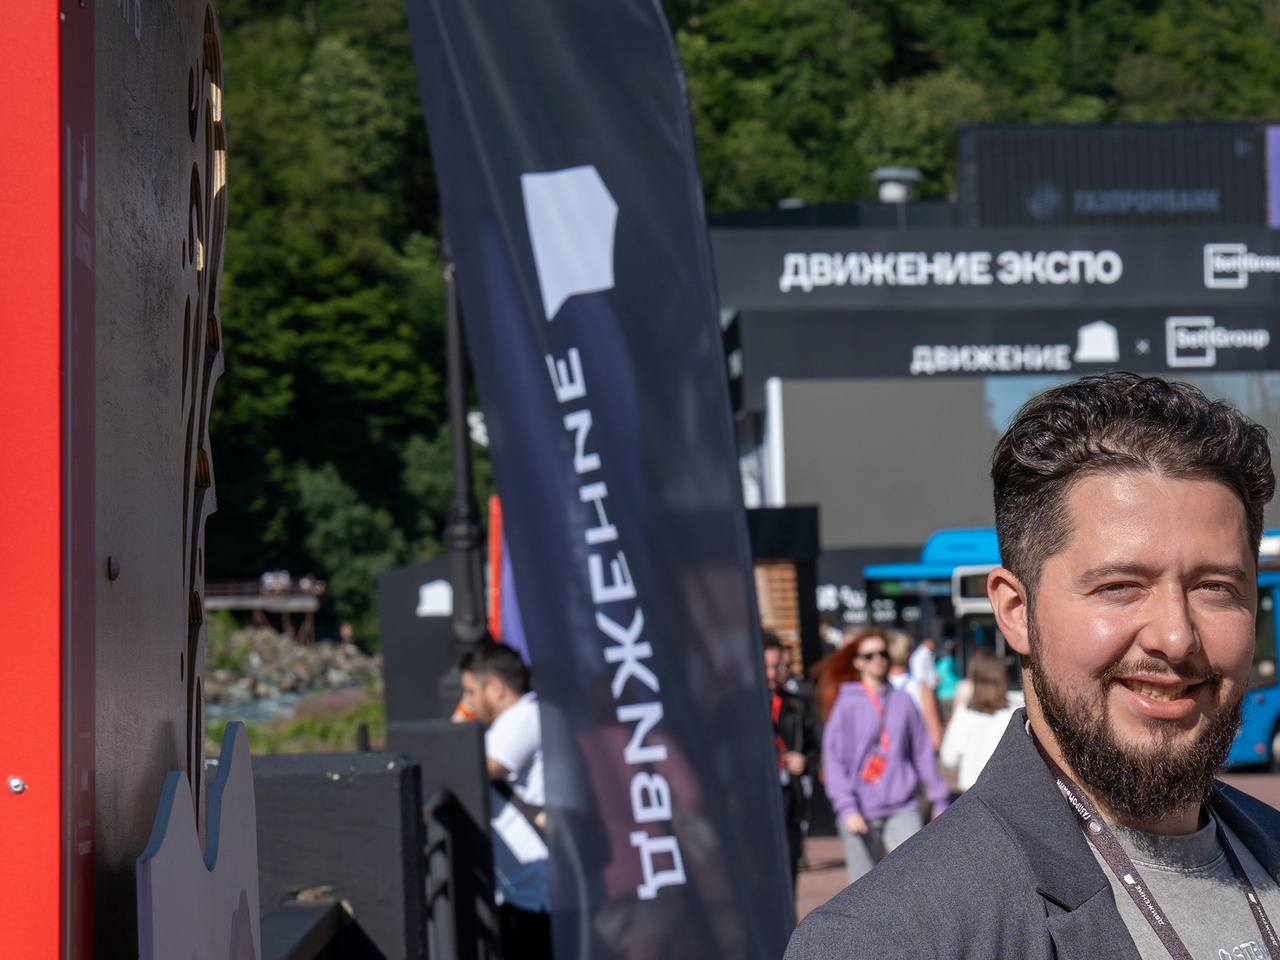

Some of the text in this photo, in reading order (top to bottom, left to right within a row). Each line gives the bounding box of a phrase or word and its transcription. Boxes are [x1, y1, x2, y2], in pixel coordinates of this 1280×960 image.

[779, 249, 1123, 293] ДВИЖЕНИЕ ЭКСПО
[910, 344, 1072, 375] ДВИЖЕНИЕ
